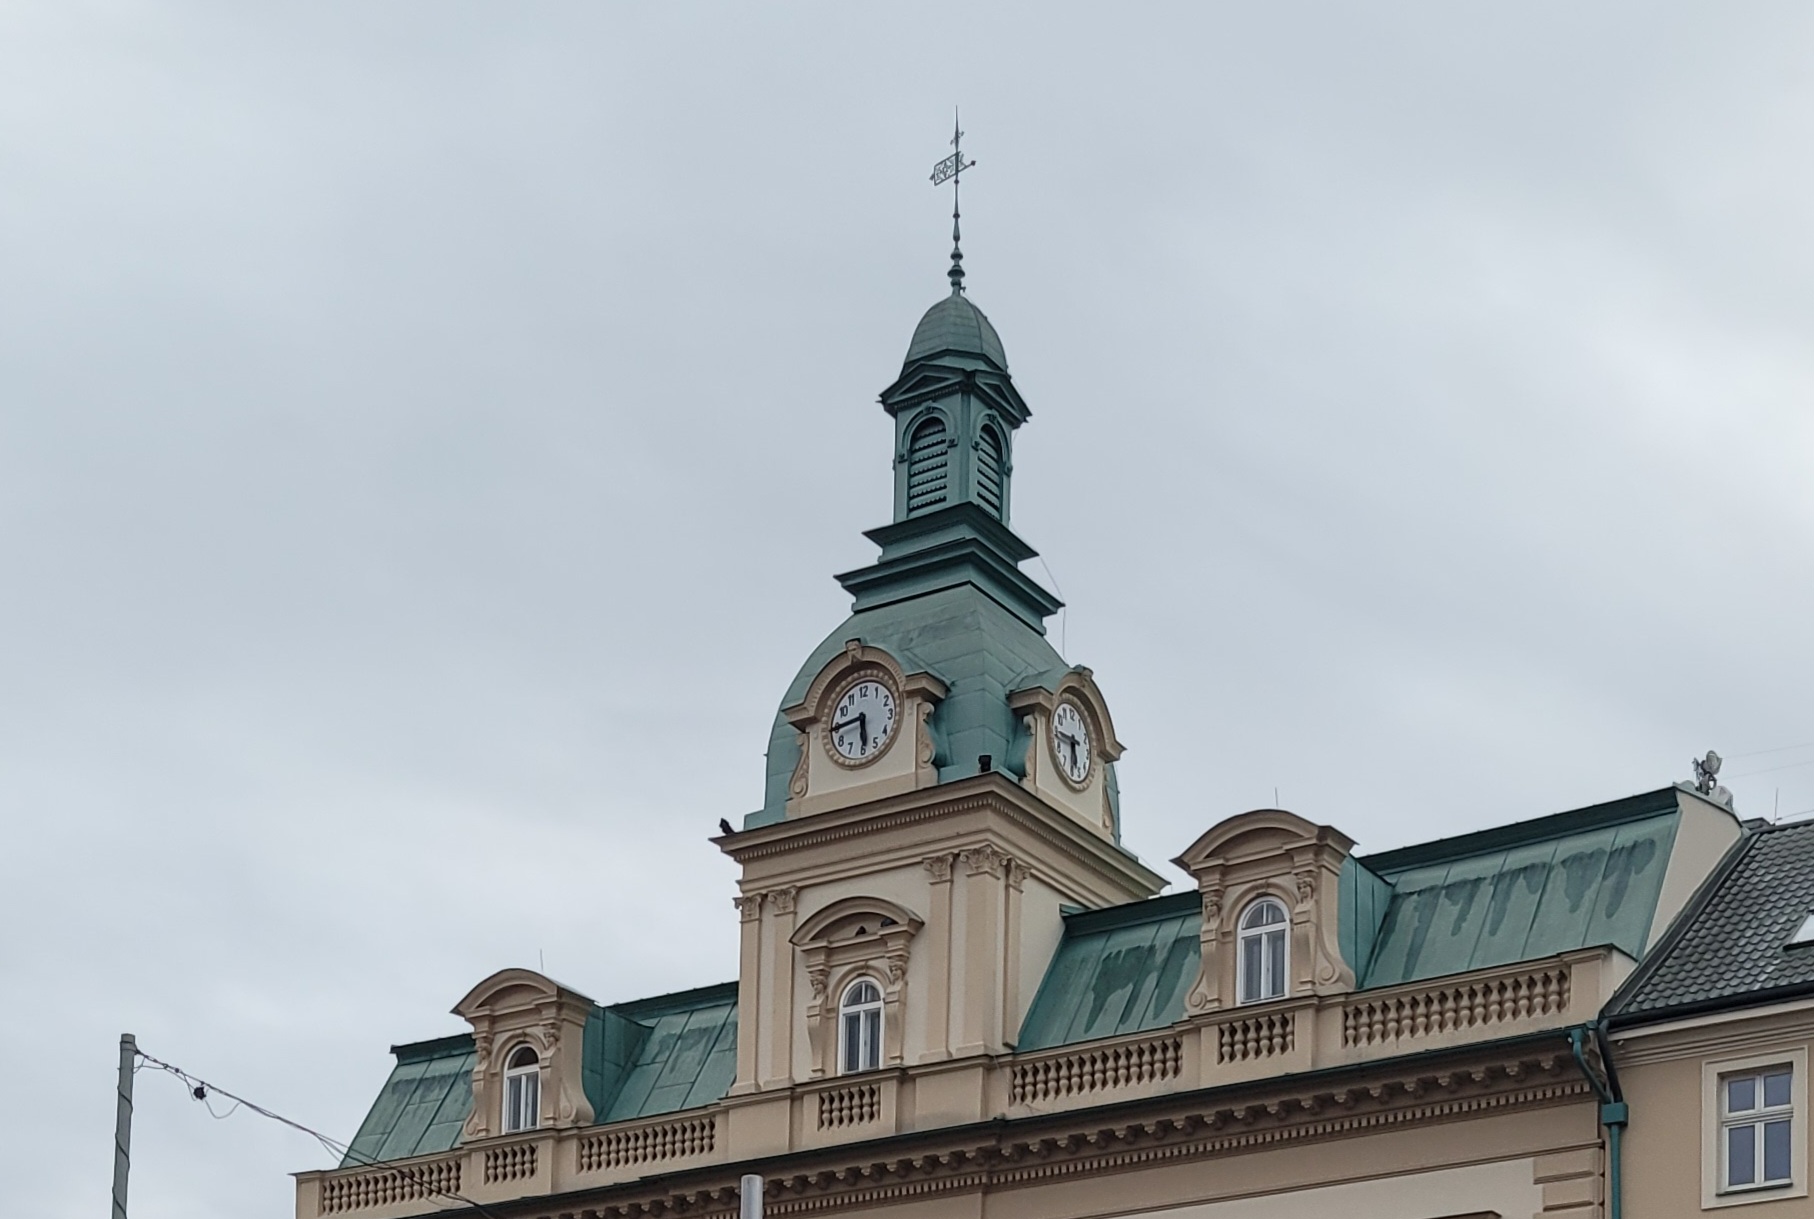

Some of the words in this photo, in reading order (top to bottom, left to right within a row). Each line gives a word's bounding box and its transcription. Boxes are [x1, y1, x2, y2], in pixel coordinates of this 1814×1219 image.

[859, 685, 869, 699] 12
[874, 686, 879, 699] 1
[848, 693, 855, 706] 11
[883, 695, 889, 707] 2
[839, 705, 848, 718] 10
[887, 708, 893, 720] 3
[882, 724, 888, 736] 4
[838, 735, 844, 748] 8
[872, 736, 879, 749] 5
[848, 742, 854, 755] 7
[860, 743, 866, 756] 6
